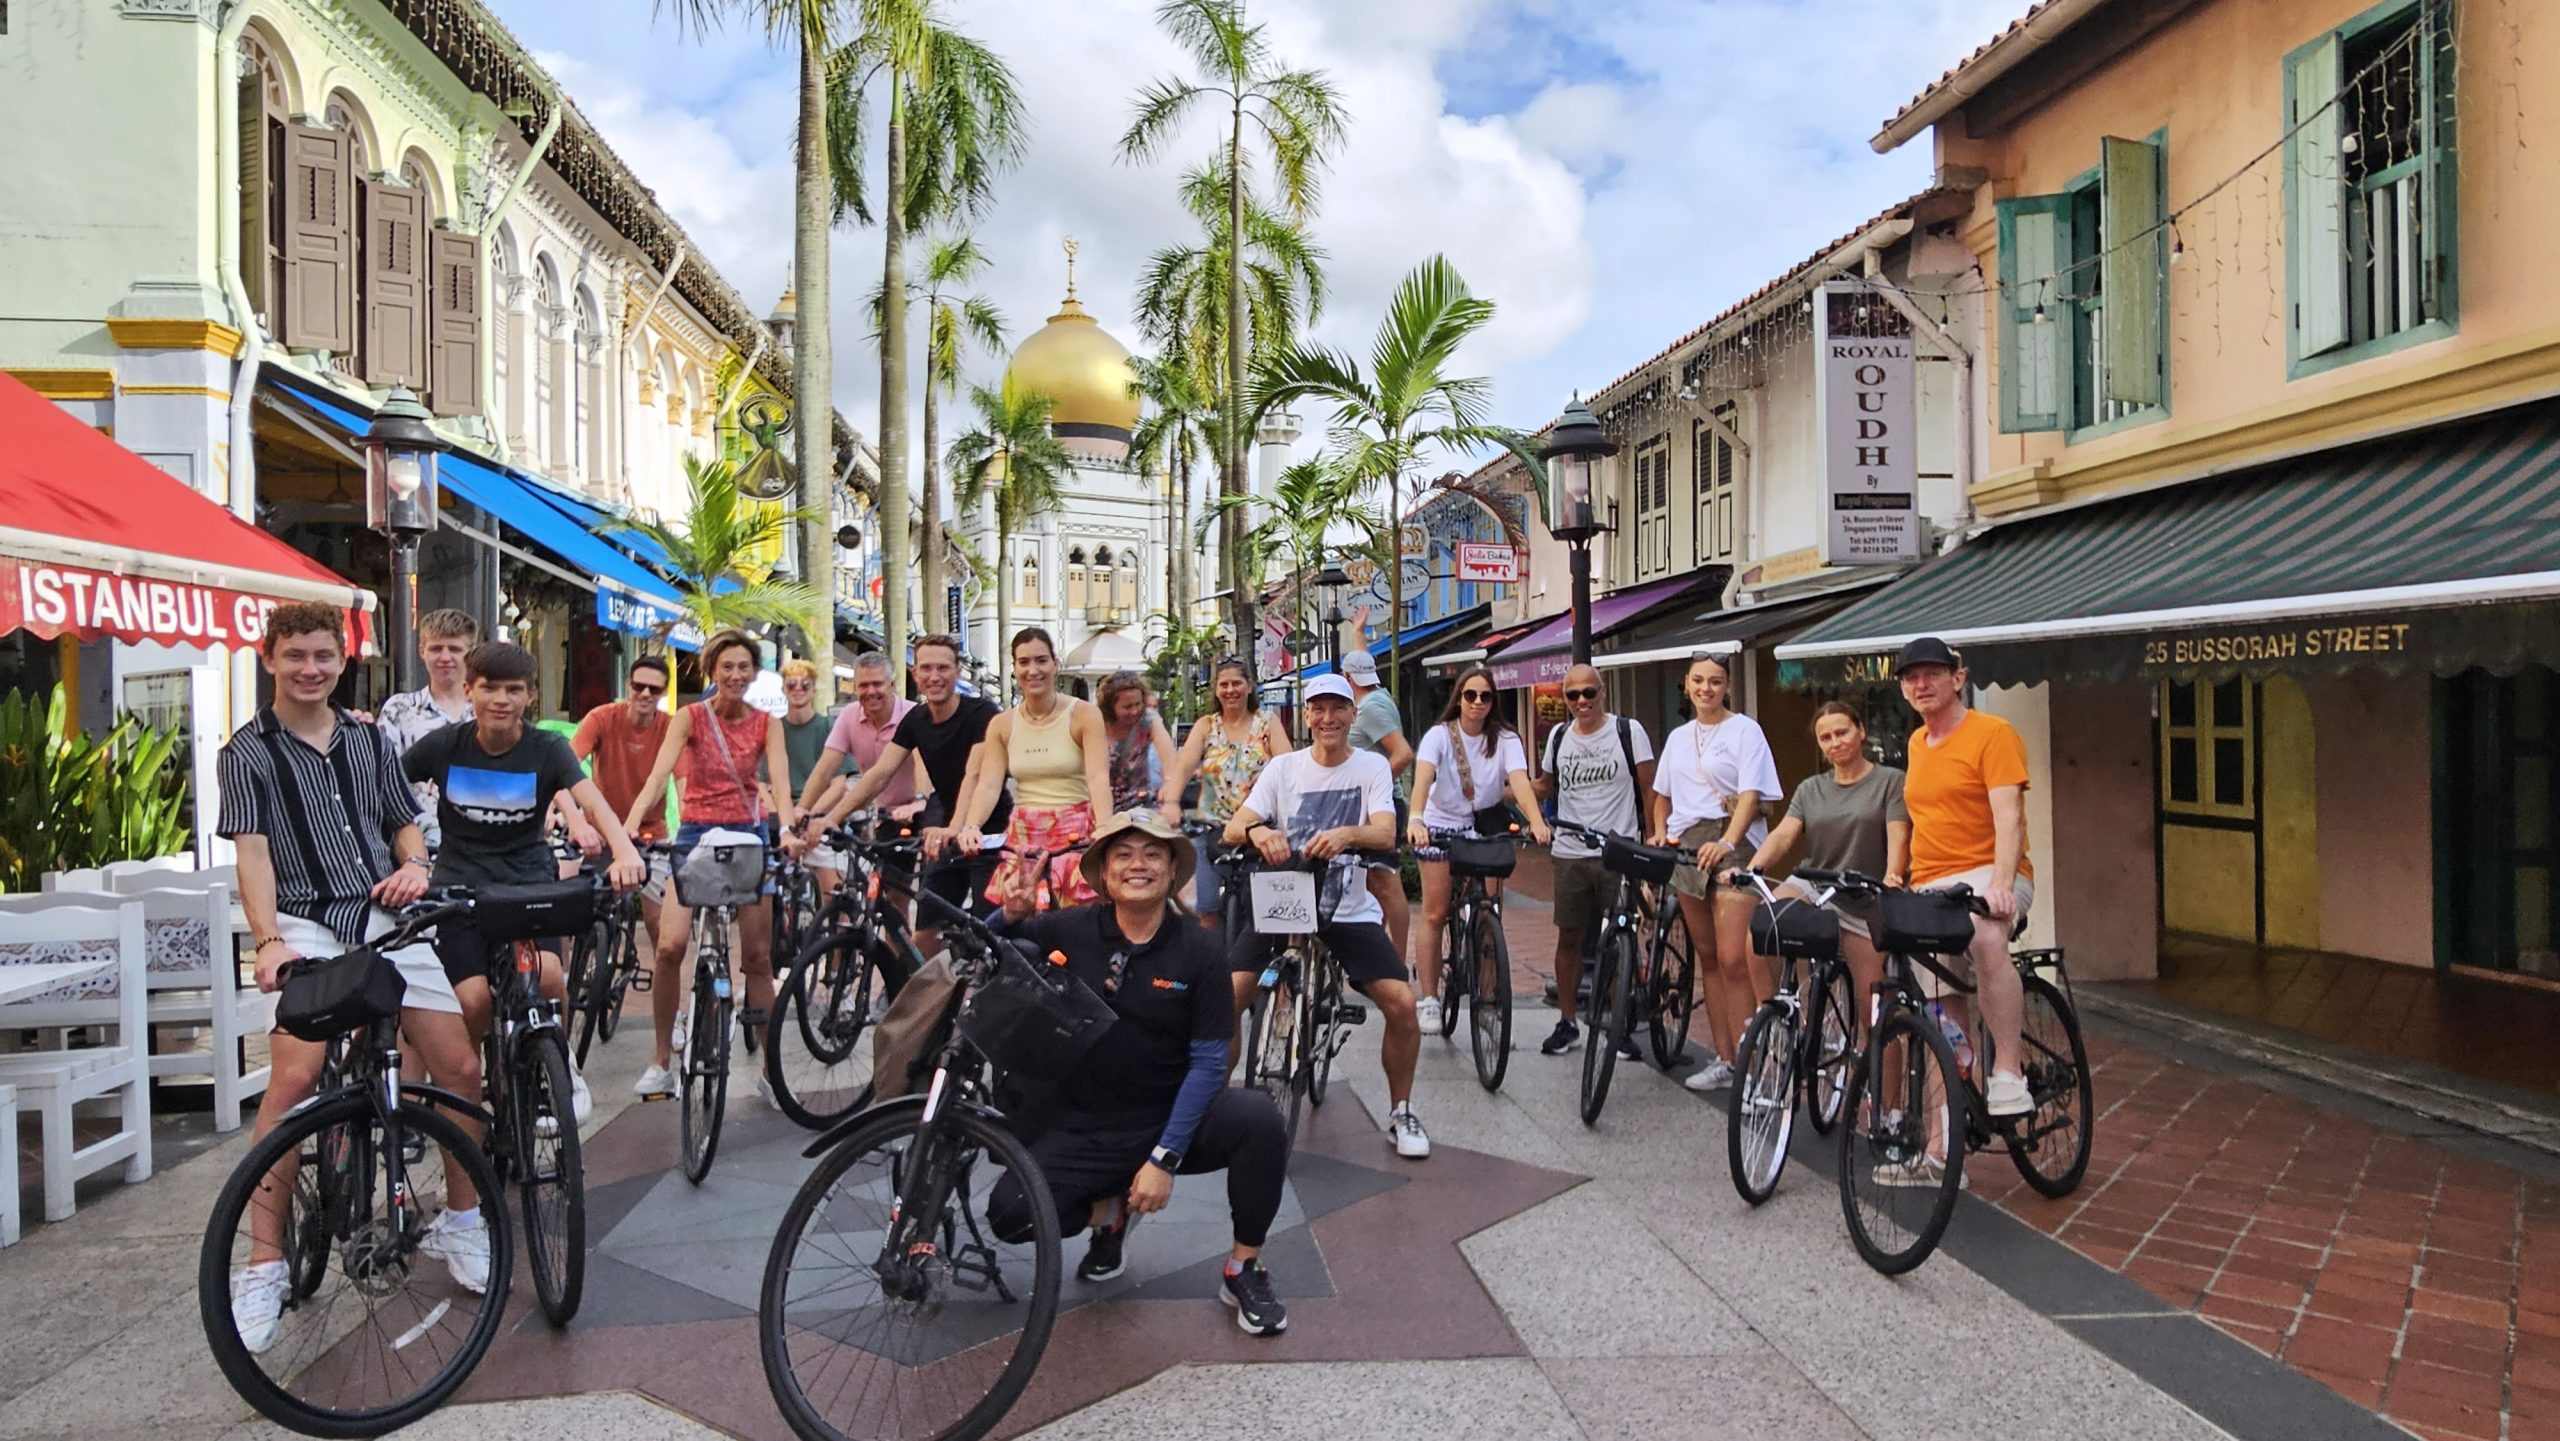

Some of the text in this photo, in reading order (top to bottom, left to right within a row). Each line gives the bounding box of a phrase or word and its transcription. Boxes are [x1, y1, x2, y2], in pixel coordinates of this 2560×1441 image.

[1832, 346, 1909, 359] ROYAL
[1854, 364, 1890, 466] OUDH
[1866, 474, 1879, 489] By
[19, 566, 227, 638] ISTANBUL
[2144, 624, 2410, 663] 25 BUSSORAH STREET
[1272, 883, 1295, 892] TOUR
